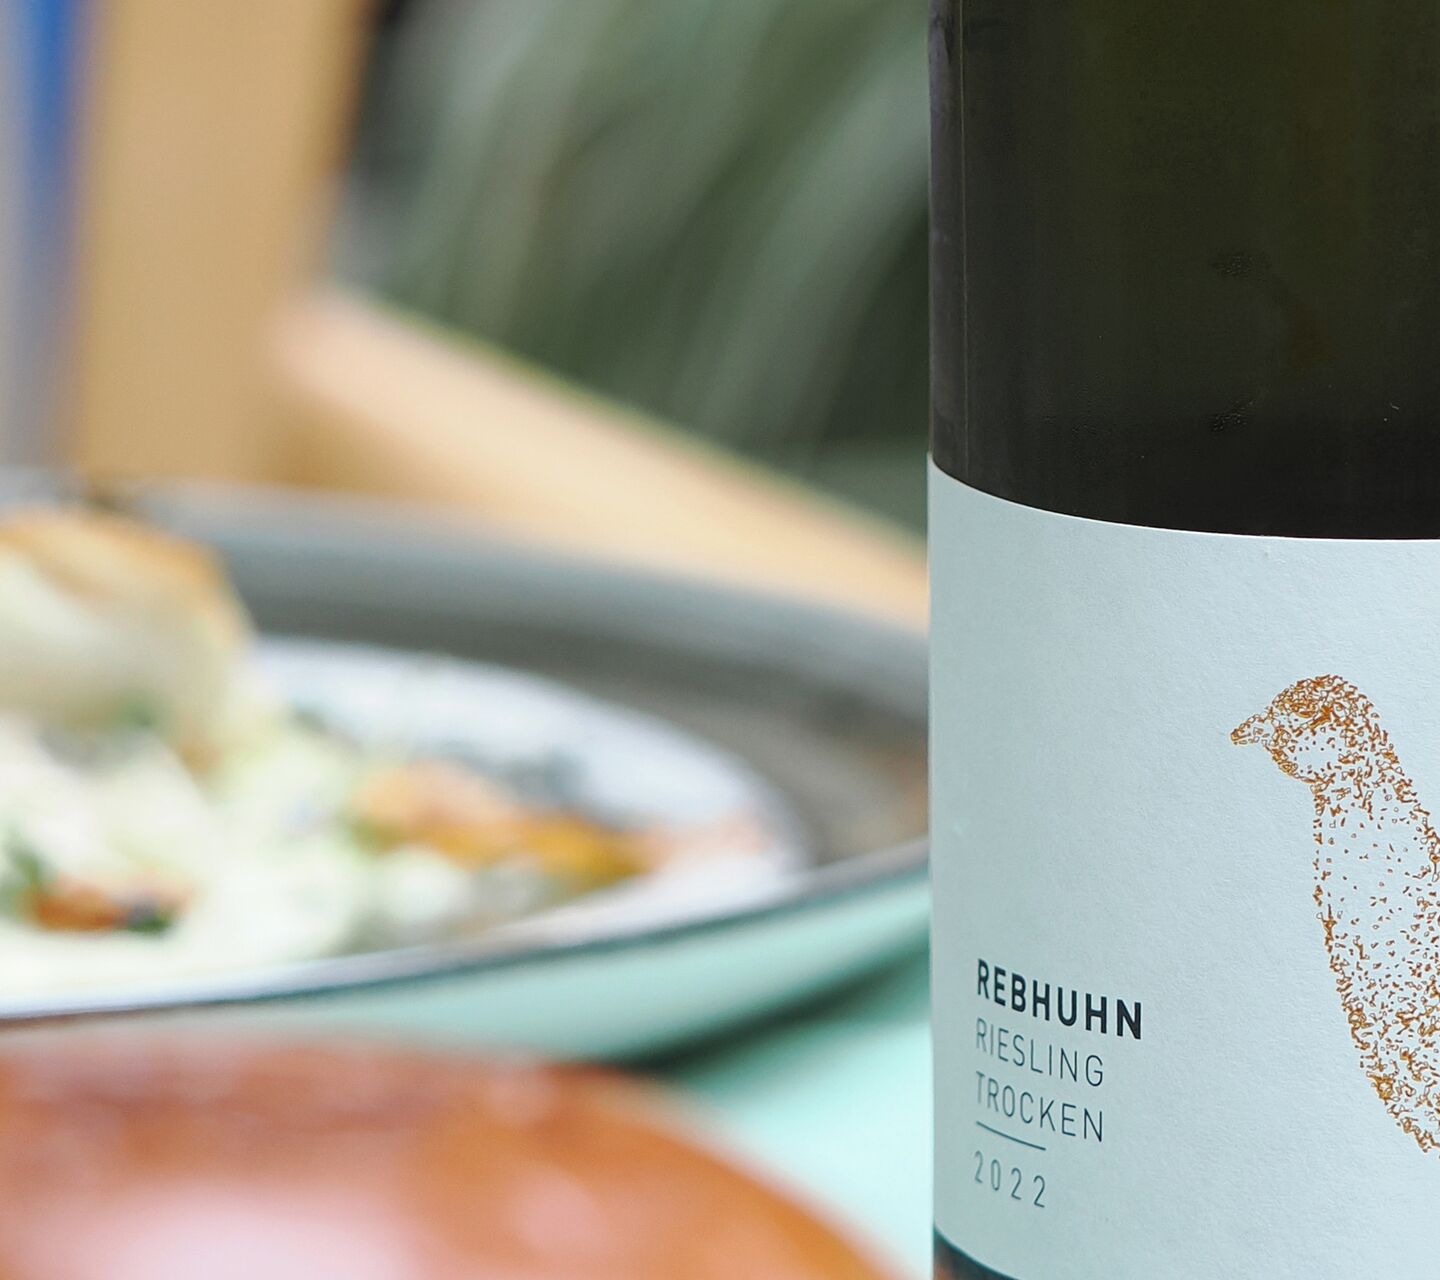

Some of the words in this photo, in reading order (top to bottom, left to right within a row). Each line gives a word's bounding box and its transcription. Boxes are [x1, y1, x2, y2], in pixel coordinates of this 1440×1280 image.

[976, 958, 1143, 1041] REBHUHN
[975, 1017, 1104, 1087] RIESLING
[975, 1070, 1104, 1143] TROCKEN
[974, 1150, 1047, 1209] 2022
